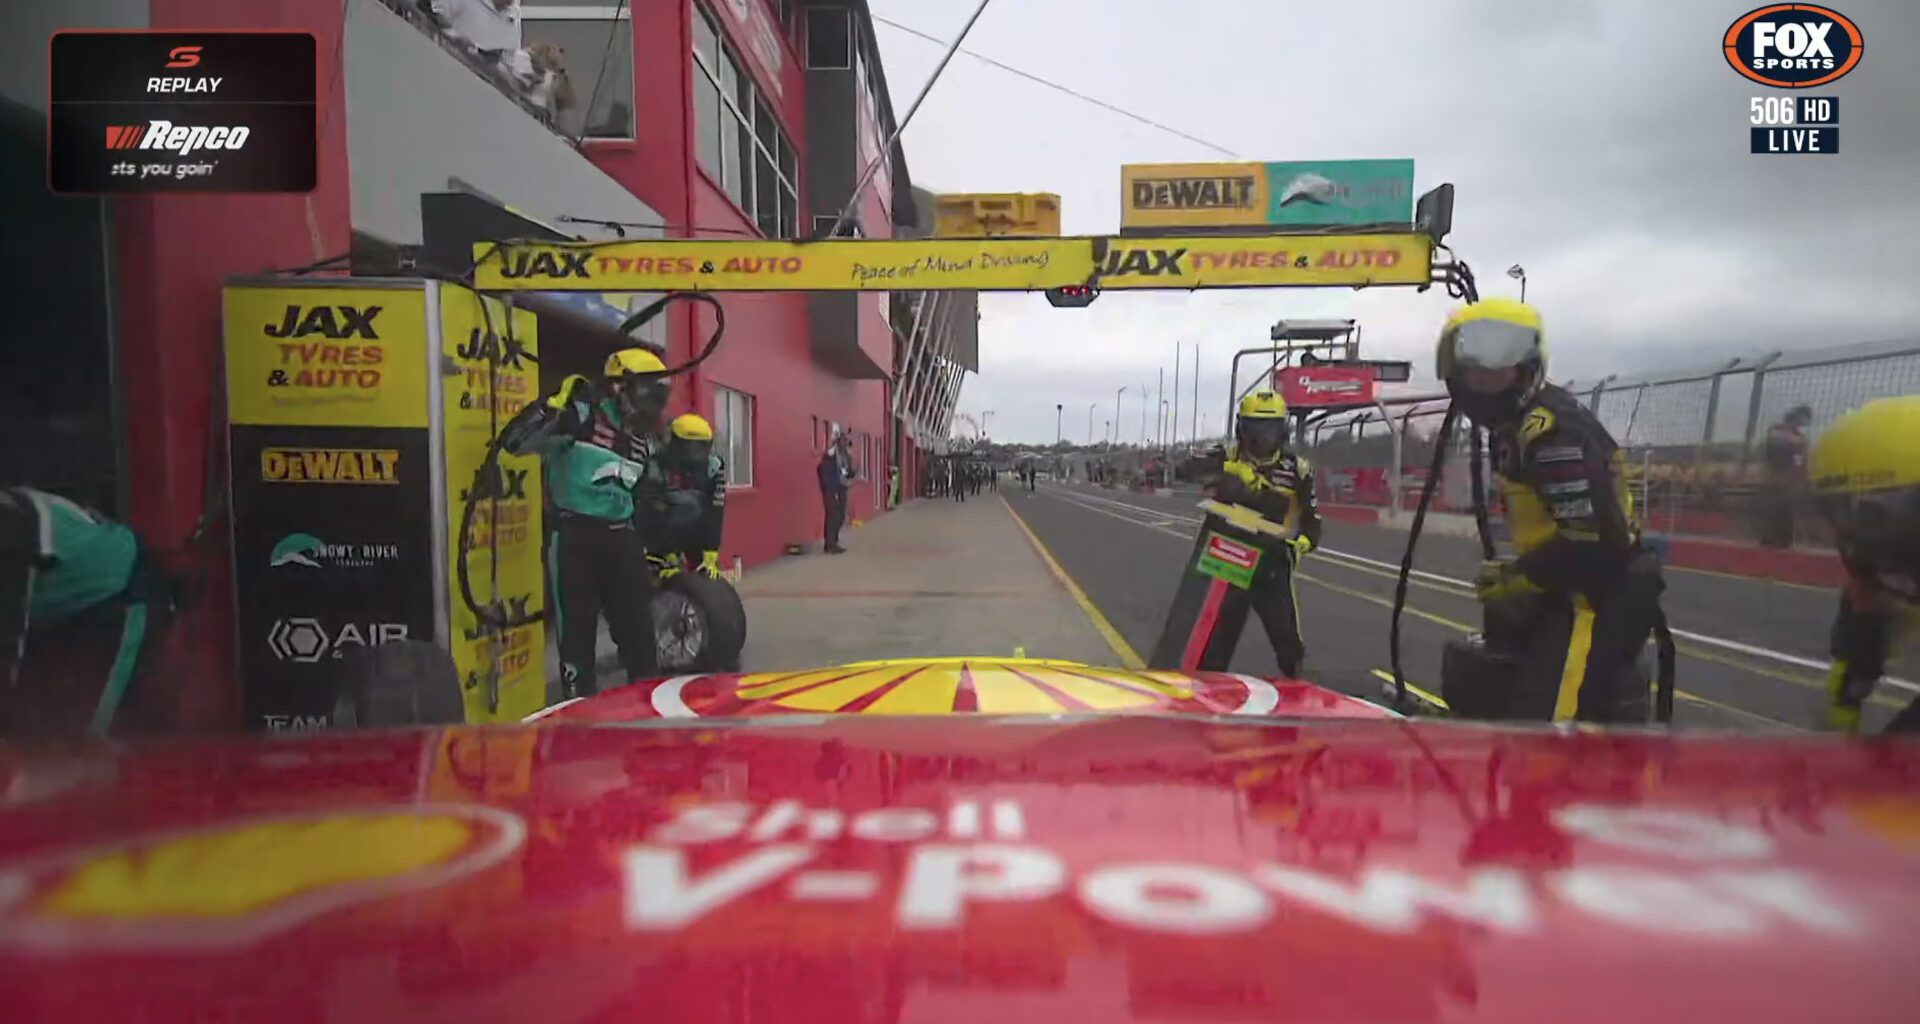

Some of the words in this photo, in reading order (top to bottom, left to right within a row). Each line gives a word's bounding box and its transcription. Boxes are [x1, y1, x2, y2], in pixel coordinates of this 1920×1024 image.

[501, 251, 590, 278] JAX
[599, 257, 692, 275] TYRES
[699, 260, 714, 275] &
[721, 255, 803, 275] AUTO
[1098, 248, 1186, 277] JAX
[1190, 250, 1288, 271] TYRES
[1294, 256, 1309, 269] &
[1315, 249, 1401, 269] AUTO
[263, 304, 384, 340] JAX
[277, 343, 384, 365] TYRES
[266, 369, 289, 387] &
[293, 369, 382, 389] AUTO
[363, 543, 399, 560] RIVER
